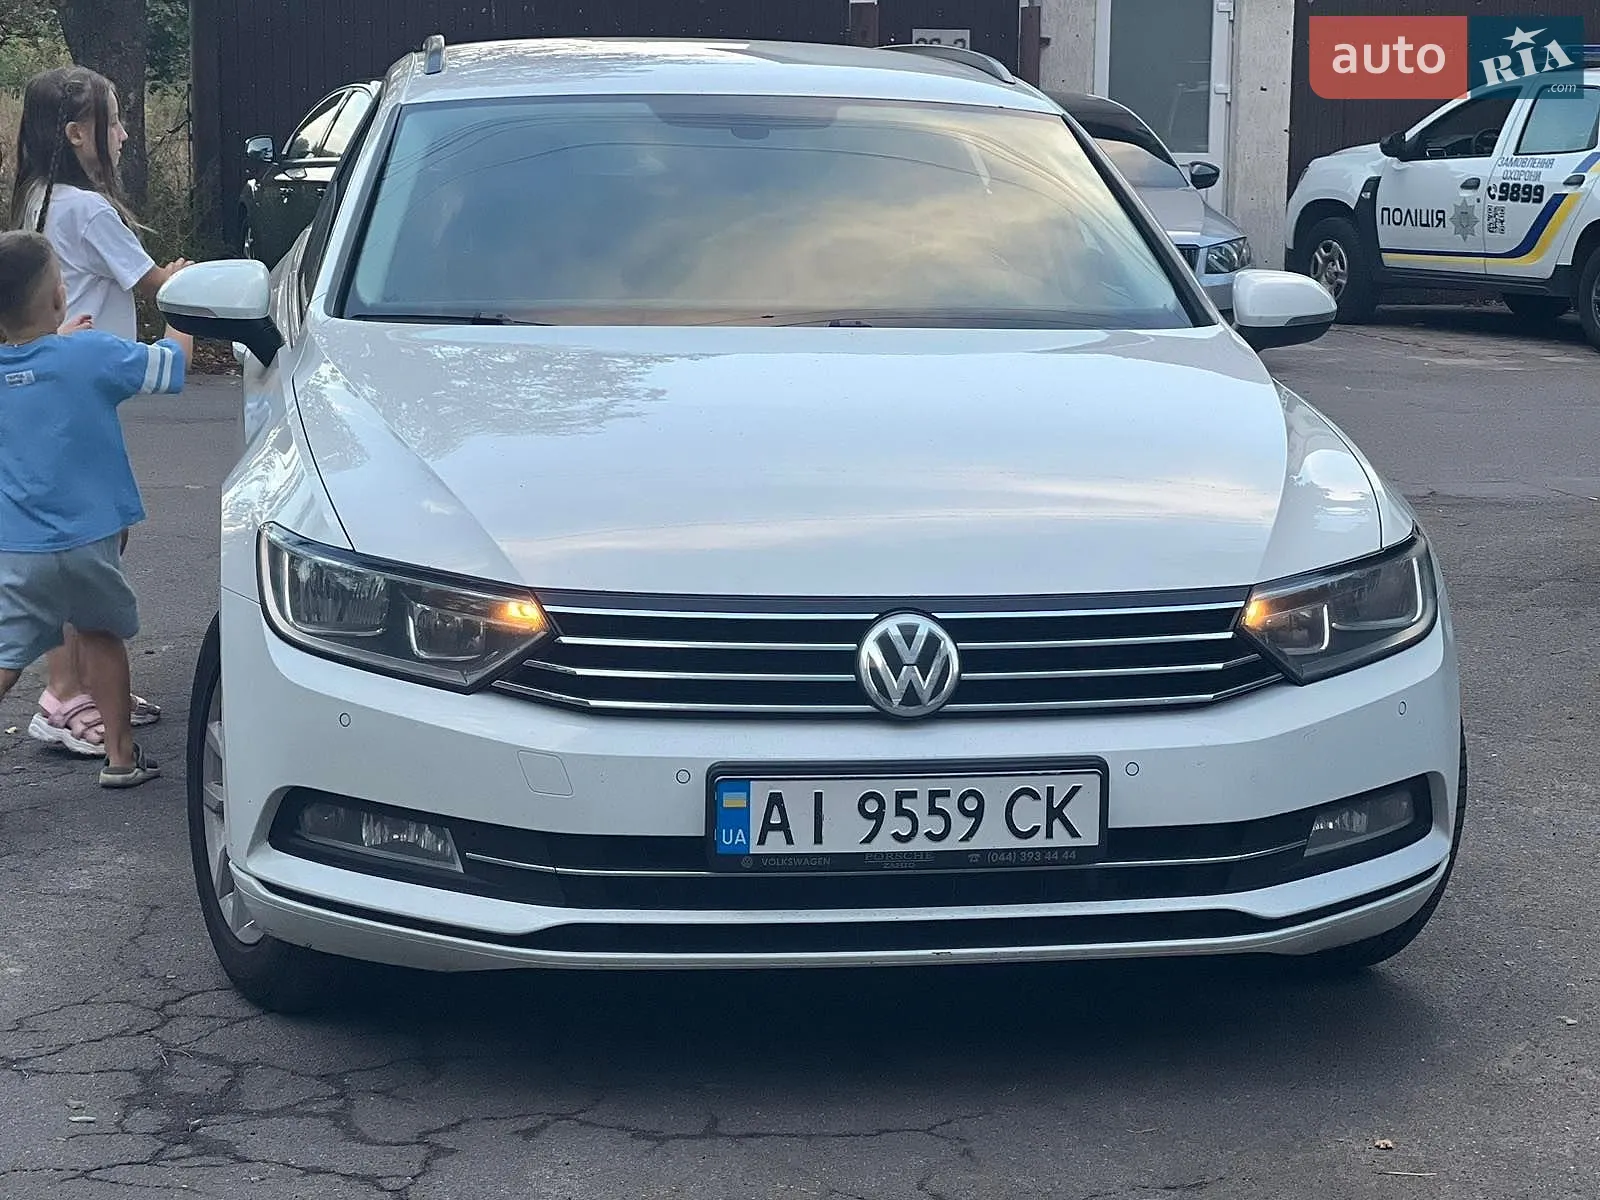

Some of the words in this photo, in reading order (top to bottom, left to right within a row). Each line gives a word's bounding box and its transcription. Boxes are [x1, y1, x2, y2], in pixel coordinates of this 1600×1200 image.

[1498, 157, 1556, 169] ЗАМОВЛЕННЯ
[1502, 169, 1542, 182] ОХОРОНИ
[1497, 182, 1545, 204] 9899
[1380, 207, 1446, 228] ПОЛІЦІЯ
[756, 790, 824, 847] AI
[857, 788, 985, 844] 9559
[1004, 783, 1083, 841] CK
[722, 829, 747, 845] UA
[761, 856, 831, 866] VOLKSWAGEN
[864, 851, 934, 861] PORSCHE
[987, 851, 1016, 864] (044)
[1020, 851, 1041, 862] 393
[1045, 850, 1059, 861] 44
[1062, 849, 1077, 860] 44
